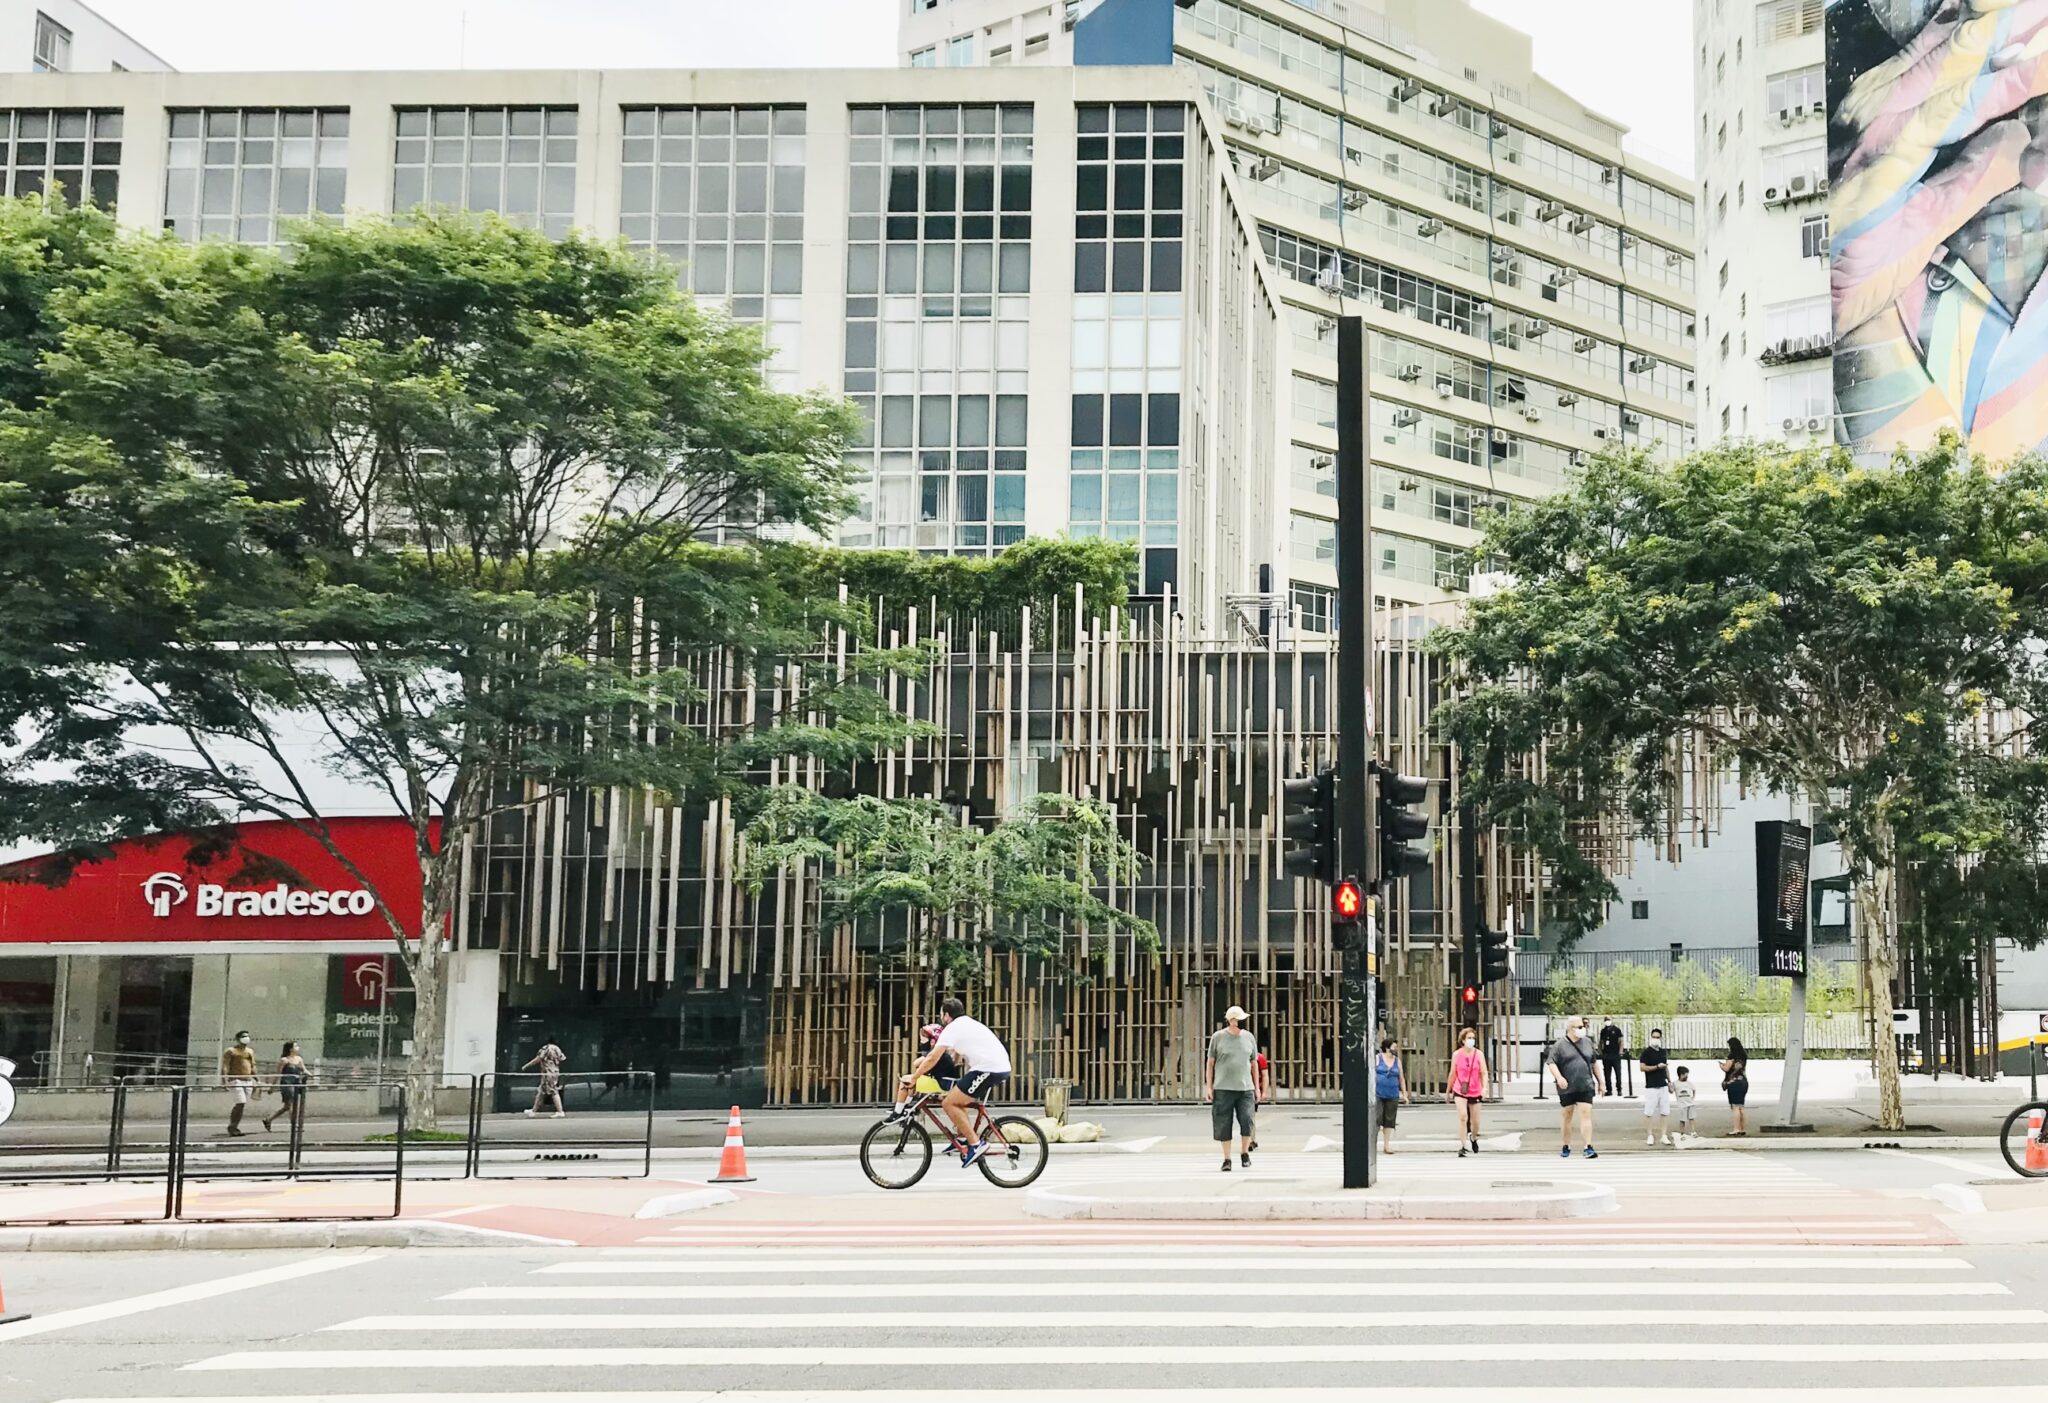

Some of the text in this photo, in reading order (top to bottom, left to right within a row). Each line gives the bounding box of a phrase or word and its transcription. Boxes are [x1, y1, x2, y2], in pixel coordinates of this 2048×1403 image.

[197, 883, 375, 916] Bradesco
[1774, 949, 1798, 971] 11:19
[336, 1012, 399, 1025] Bradesco
[967, 1072, 991, 1094] adidas
